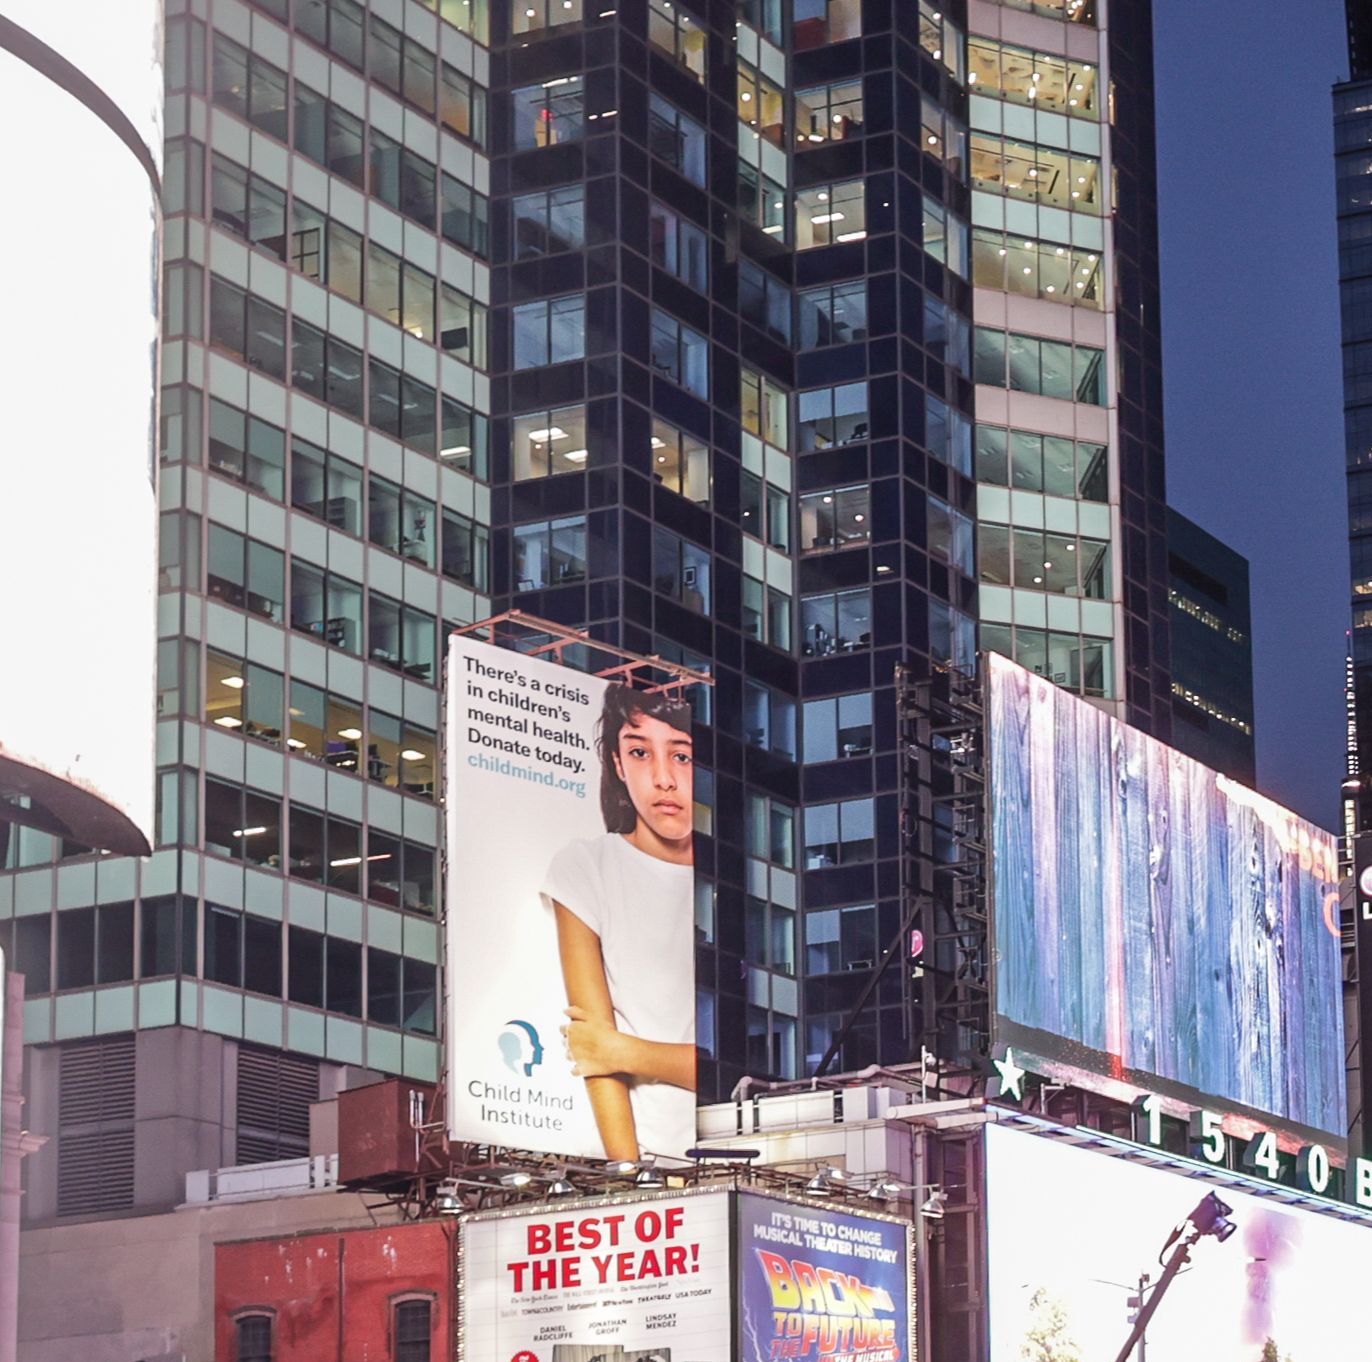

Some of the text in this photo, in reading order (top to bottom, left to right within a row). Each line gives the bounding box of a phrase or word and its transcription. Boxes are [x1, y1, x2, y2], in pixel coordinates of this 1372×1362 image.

[463, 656, 590, 705] There's a crisis
[467, 681, 571, 722] in children's
[468, 707, 590, 750] mental health.
[468, 728, 586, 773] Donate today.
[468, 753, 586, 798] childmind.org
[468, 1079, 574, 1111] Child Mind
[481, 1104, 563, 1132] Institute
[527, 1207, 684, 1255] BEST OF
[753, 1225, 898, 1264] MUSICAL THEATER HISTORY
[771, 1212, 881, 1246] IT'S TIME TO CHANGE
[507, 1244, 700, 1293] THE YEAR!
[540, 1325, 566, 1334] DANIEL
[588, 1319, 627, 1329] JONATHAN
[595, 1327, 620, 1335] GROFF
[645, 1313, 677, 1322] LINDSAY
[646, 1320, 677, 1330] MENDEZ
[773, 1312, 896, 1356] TO FUTURE
[533, 1332, 573, 1342] RADCLIFFE
[770, 1339, 800, 1359] THE
